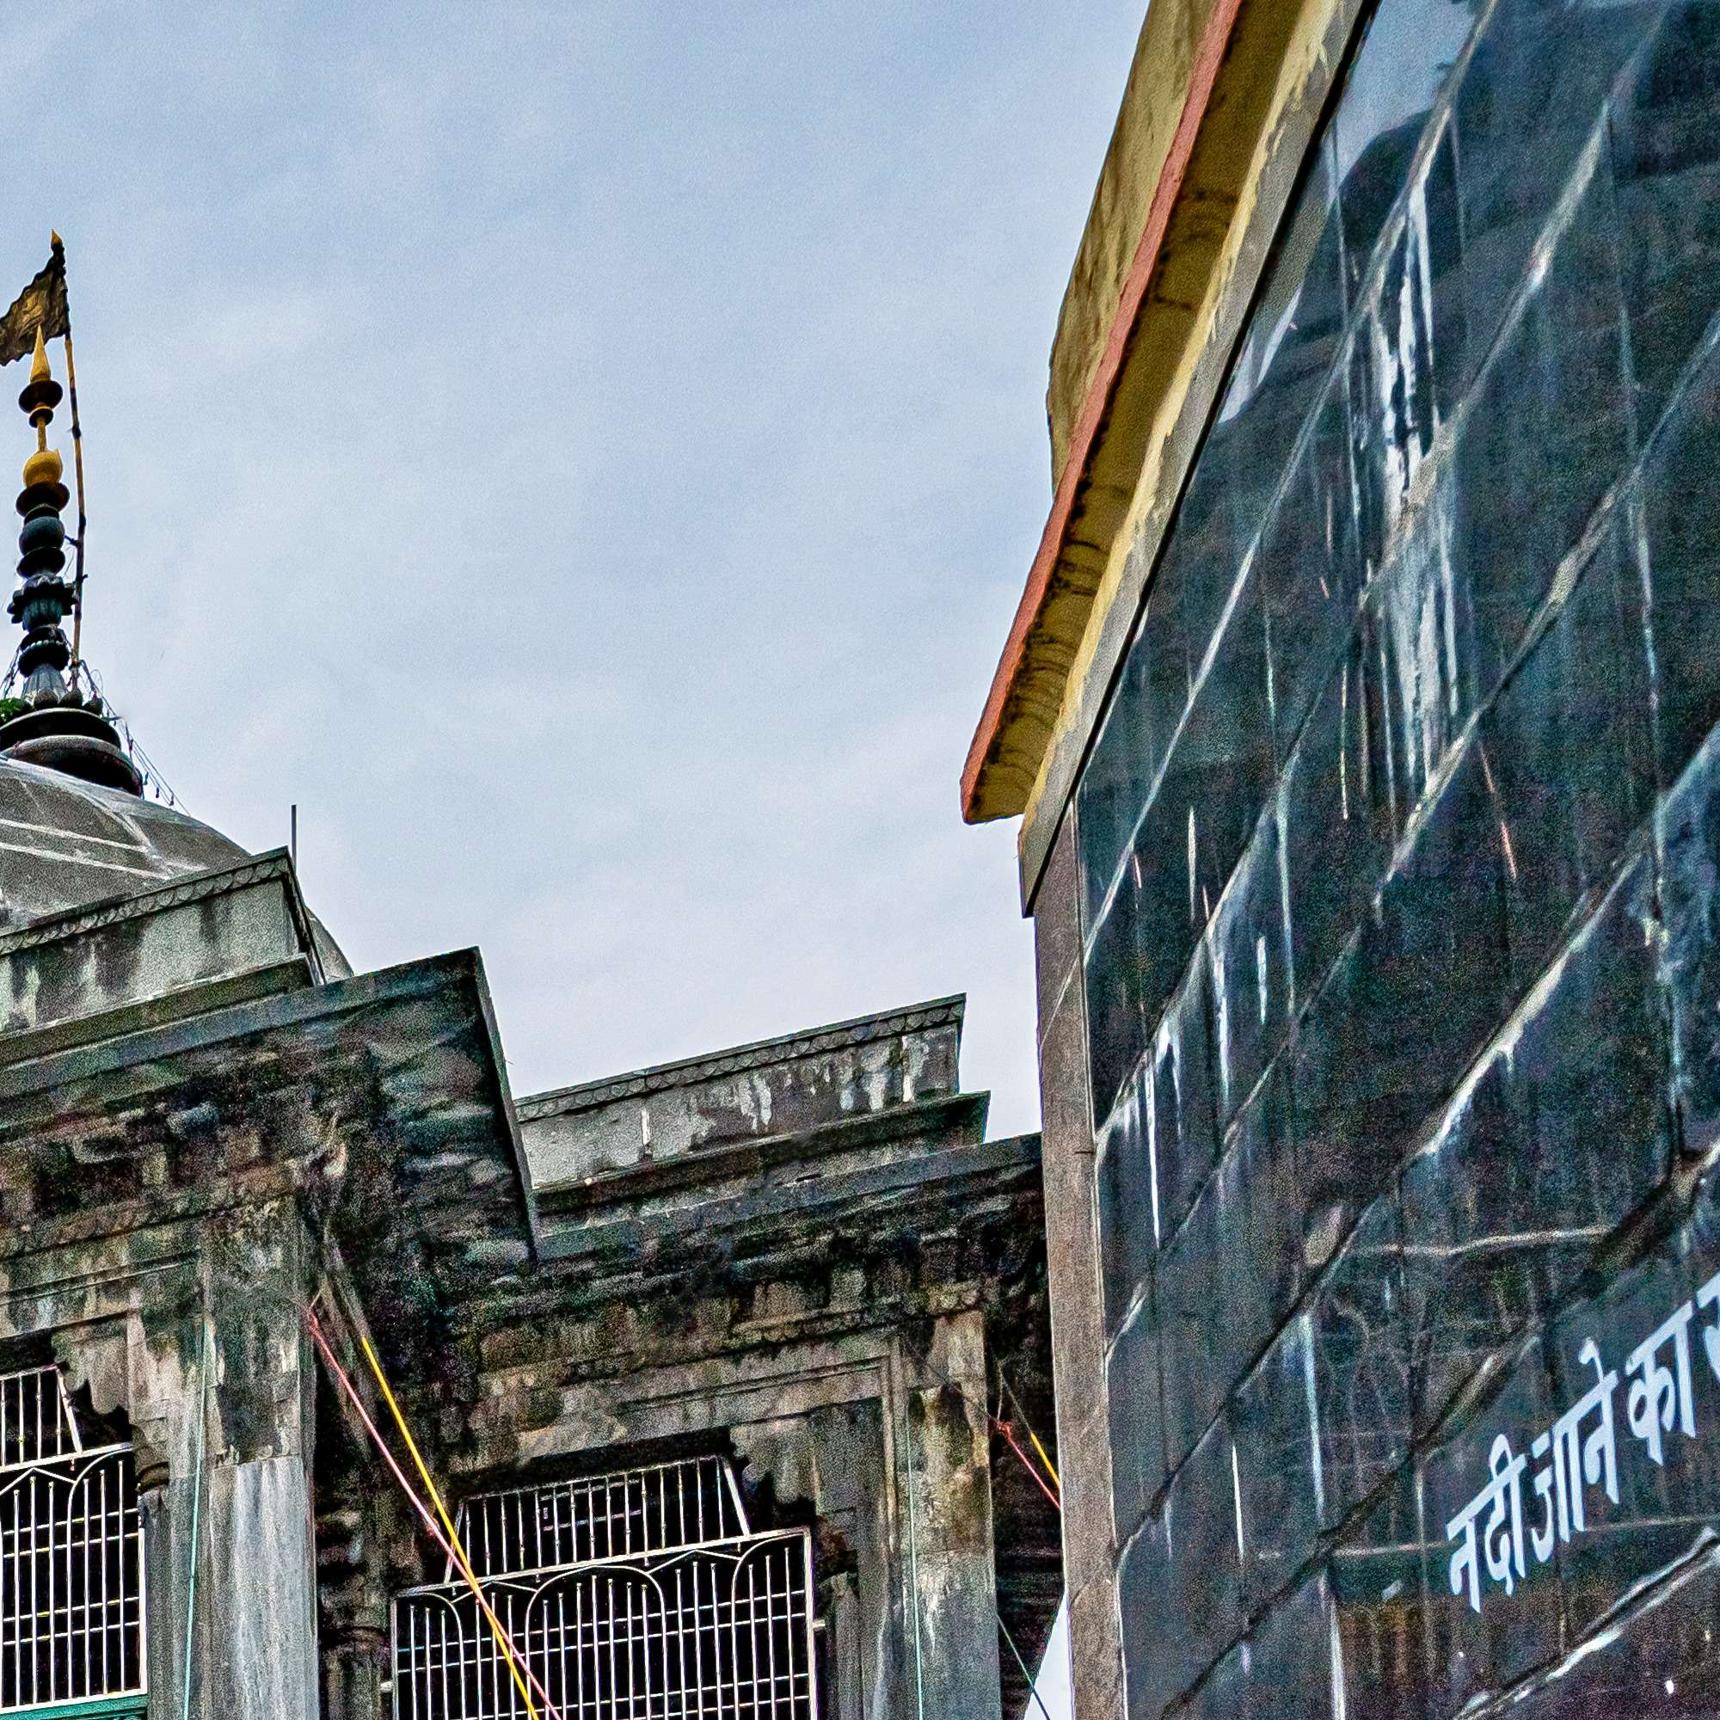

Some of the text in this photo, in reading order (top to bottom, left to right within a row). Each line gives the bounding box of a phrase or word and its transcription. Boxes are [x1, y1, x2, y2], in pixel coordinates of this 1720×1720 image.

[1446, 1433, 1526, 1614] नदी
[1531, 1336, 1620, 1563] जाने
[1625, 1301, 1697, 1466] का
